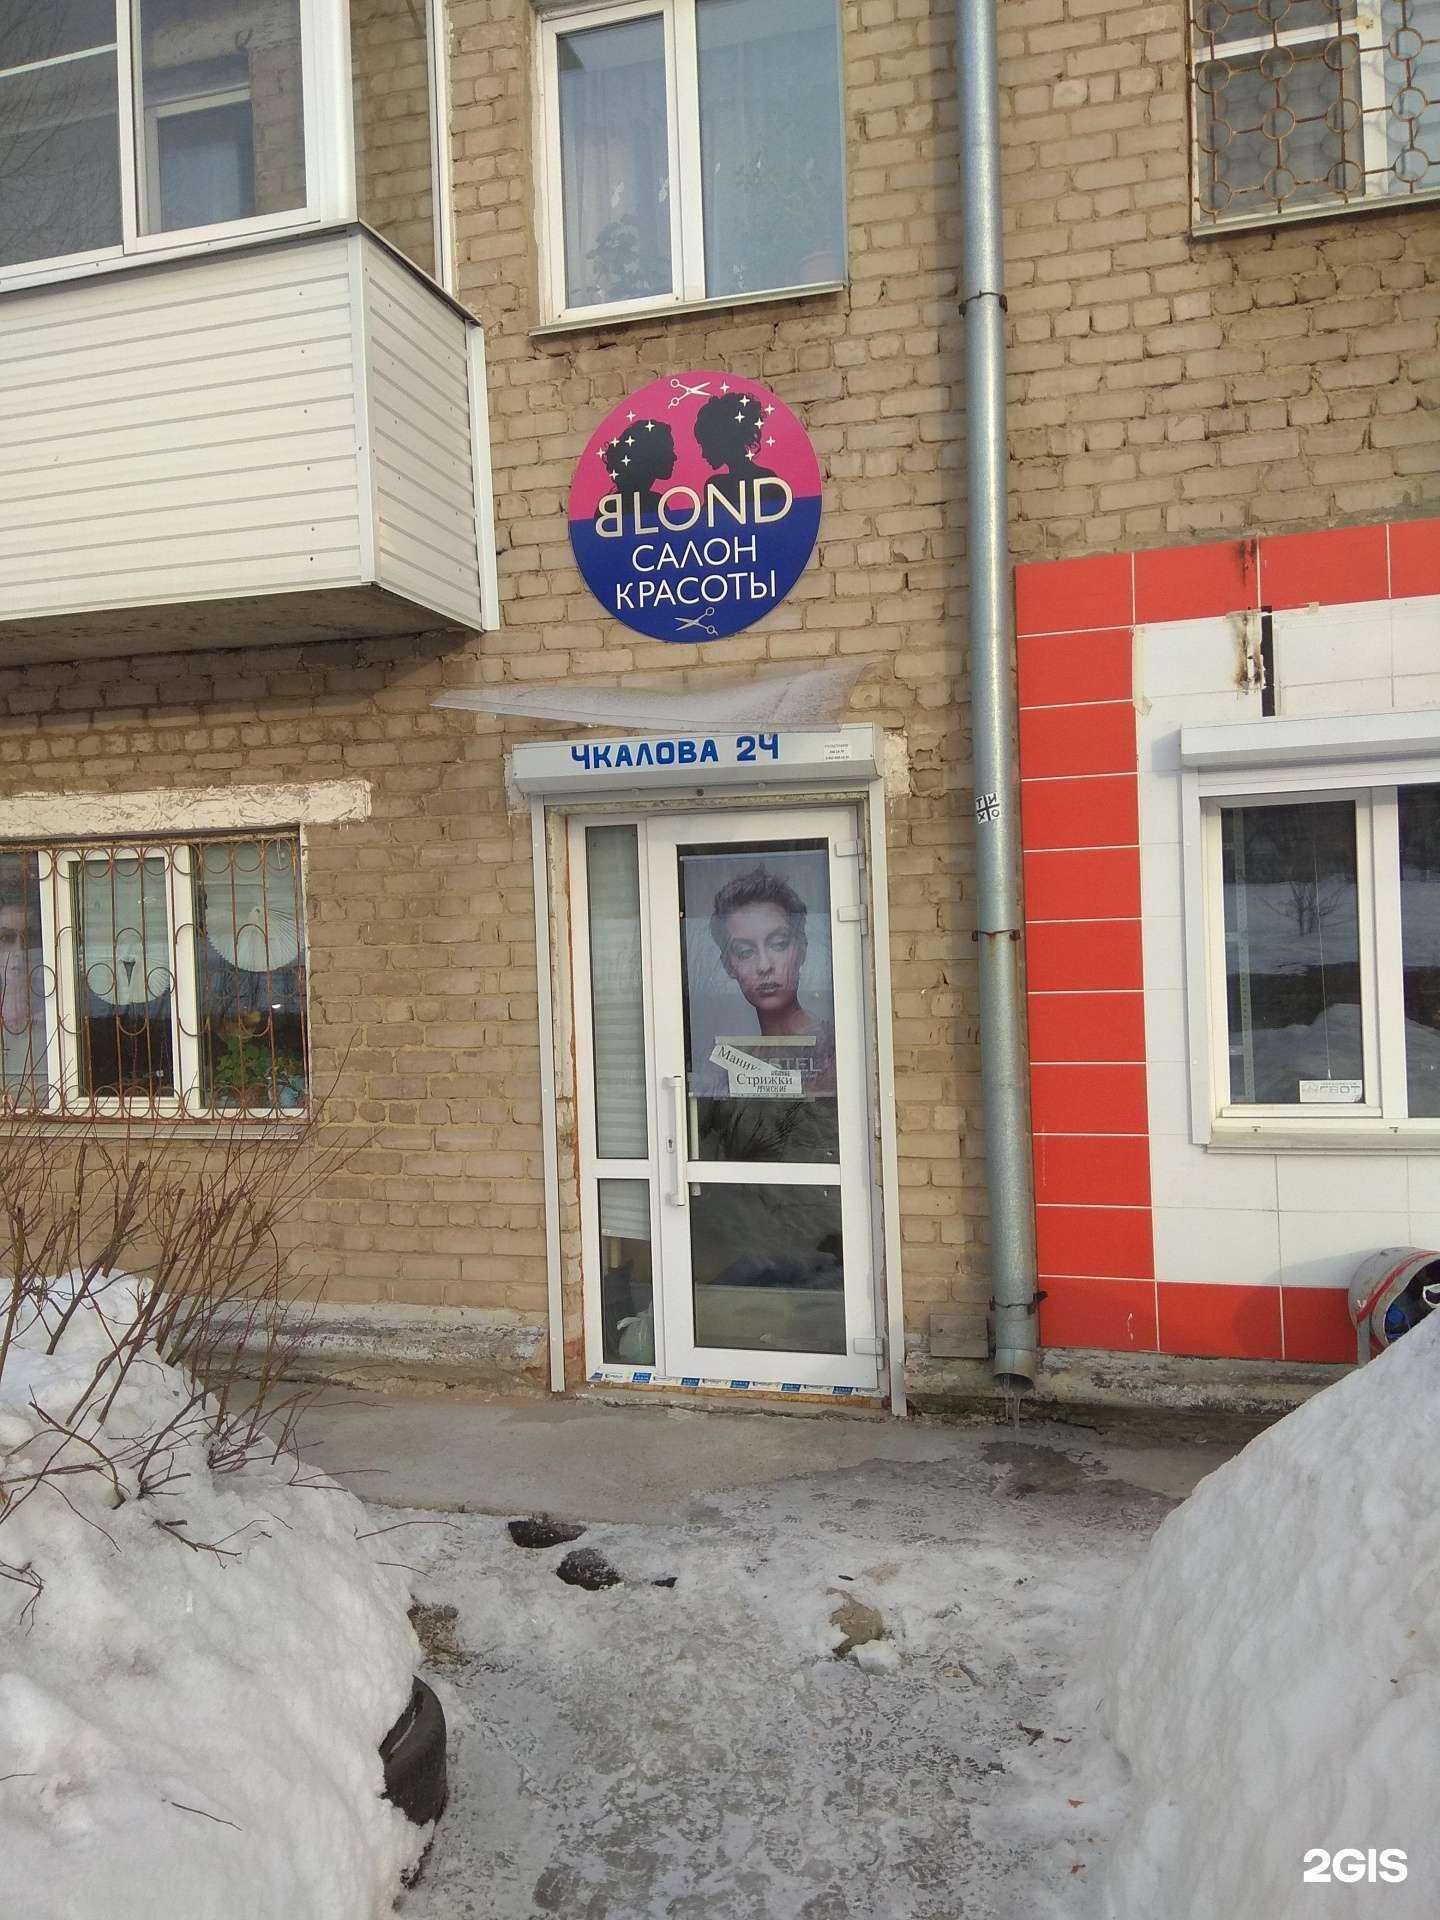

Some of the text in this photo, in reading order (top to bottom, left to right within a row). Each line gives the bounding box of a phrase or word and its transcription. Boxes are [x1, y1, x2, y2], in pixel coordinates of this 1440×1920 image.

[595, 476, 793, 538] BLOND
[631, 534, 757, 572] САЛОН
[616, 569, 777, 610] КРАСОТЫ
[571, 739, 719, 770] ЧКАЛОВА
[736, 1073, 793, 1088] Стрижки
